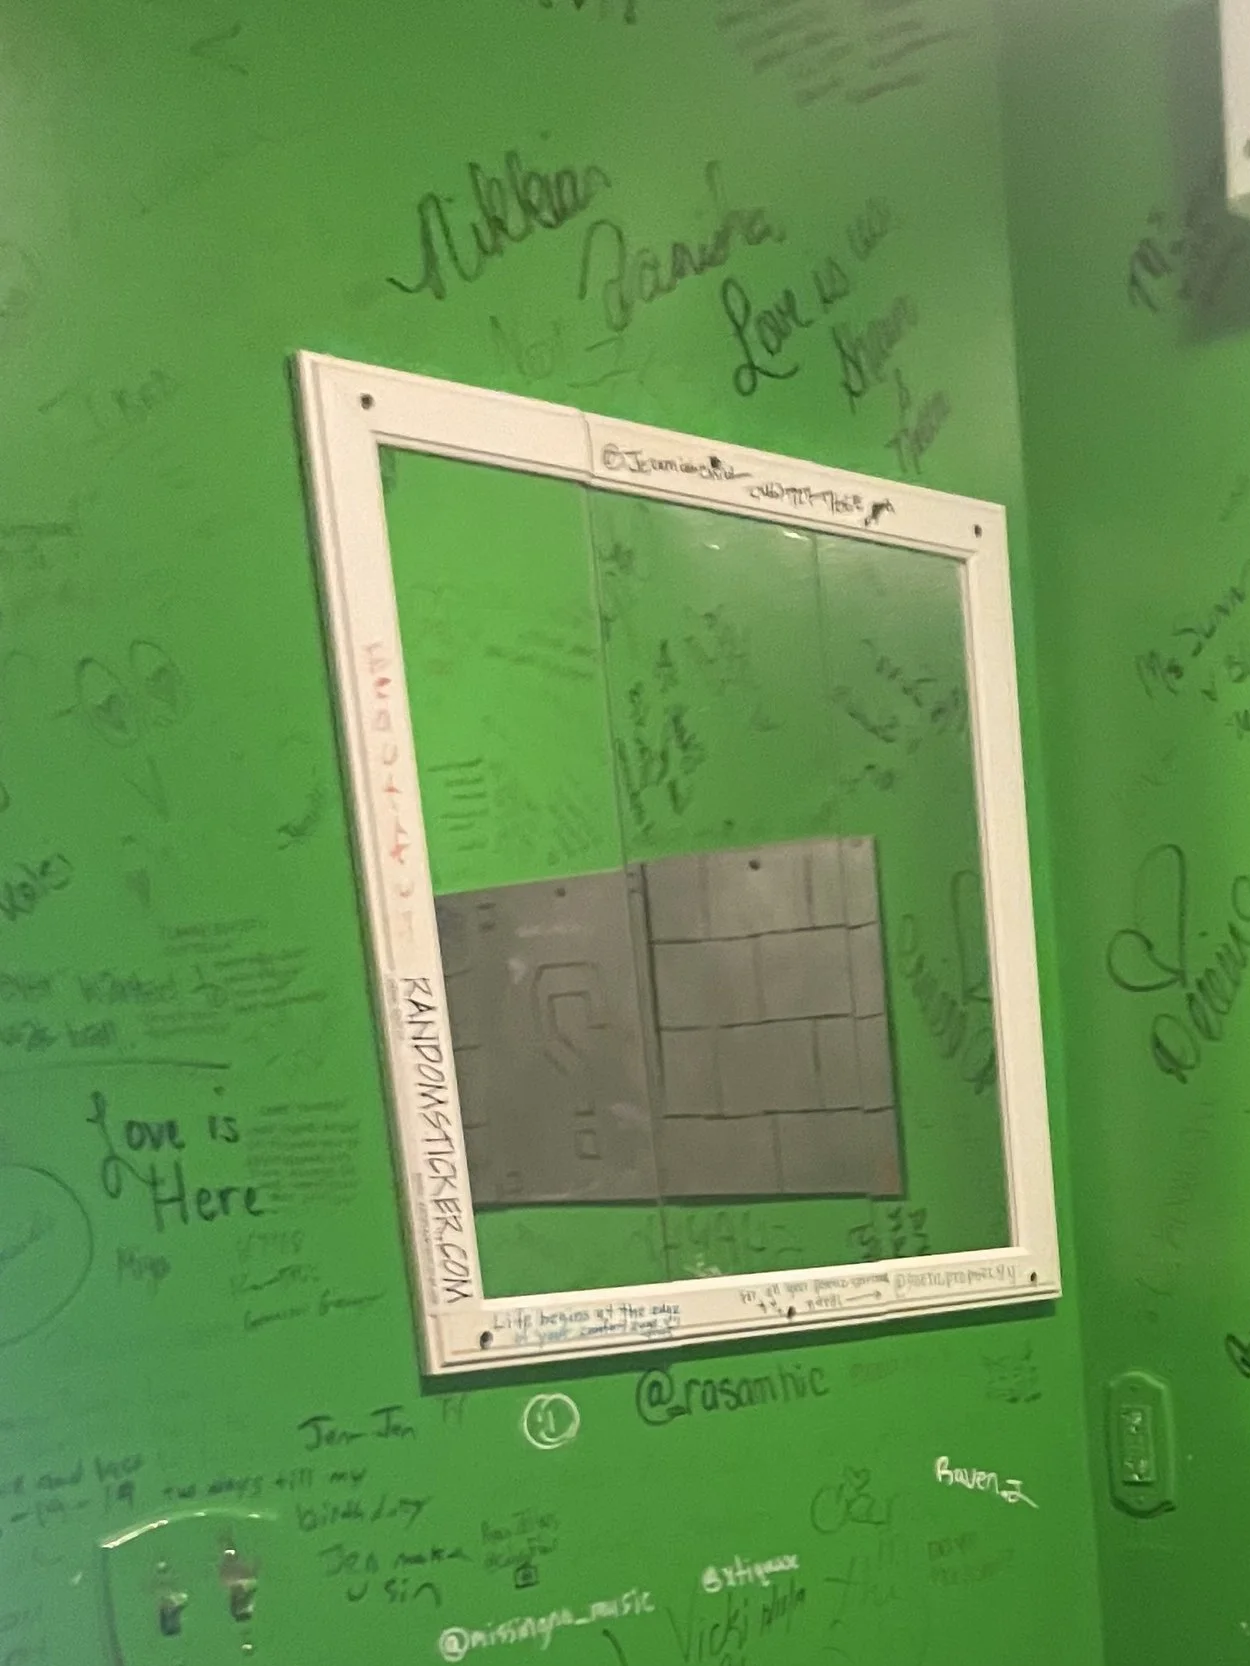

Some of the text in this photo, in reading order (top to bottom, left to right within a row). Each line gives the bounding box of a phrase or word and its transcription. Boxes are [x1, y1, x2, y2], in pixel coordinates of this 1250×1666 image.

[721, 277, 812, 398] Love
[150, 1160, 274, 1232] Here
[400, 972, 474, 1306] RANDOMSTICKER.COM
